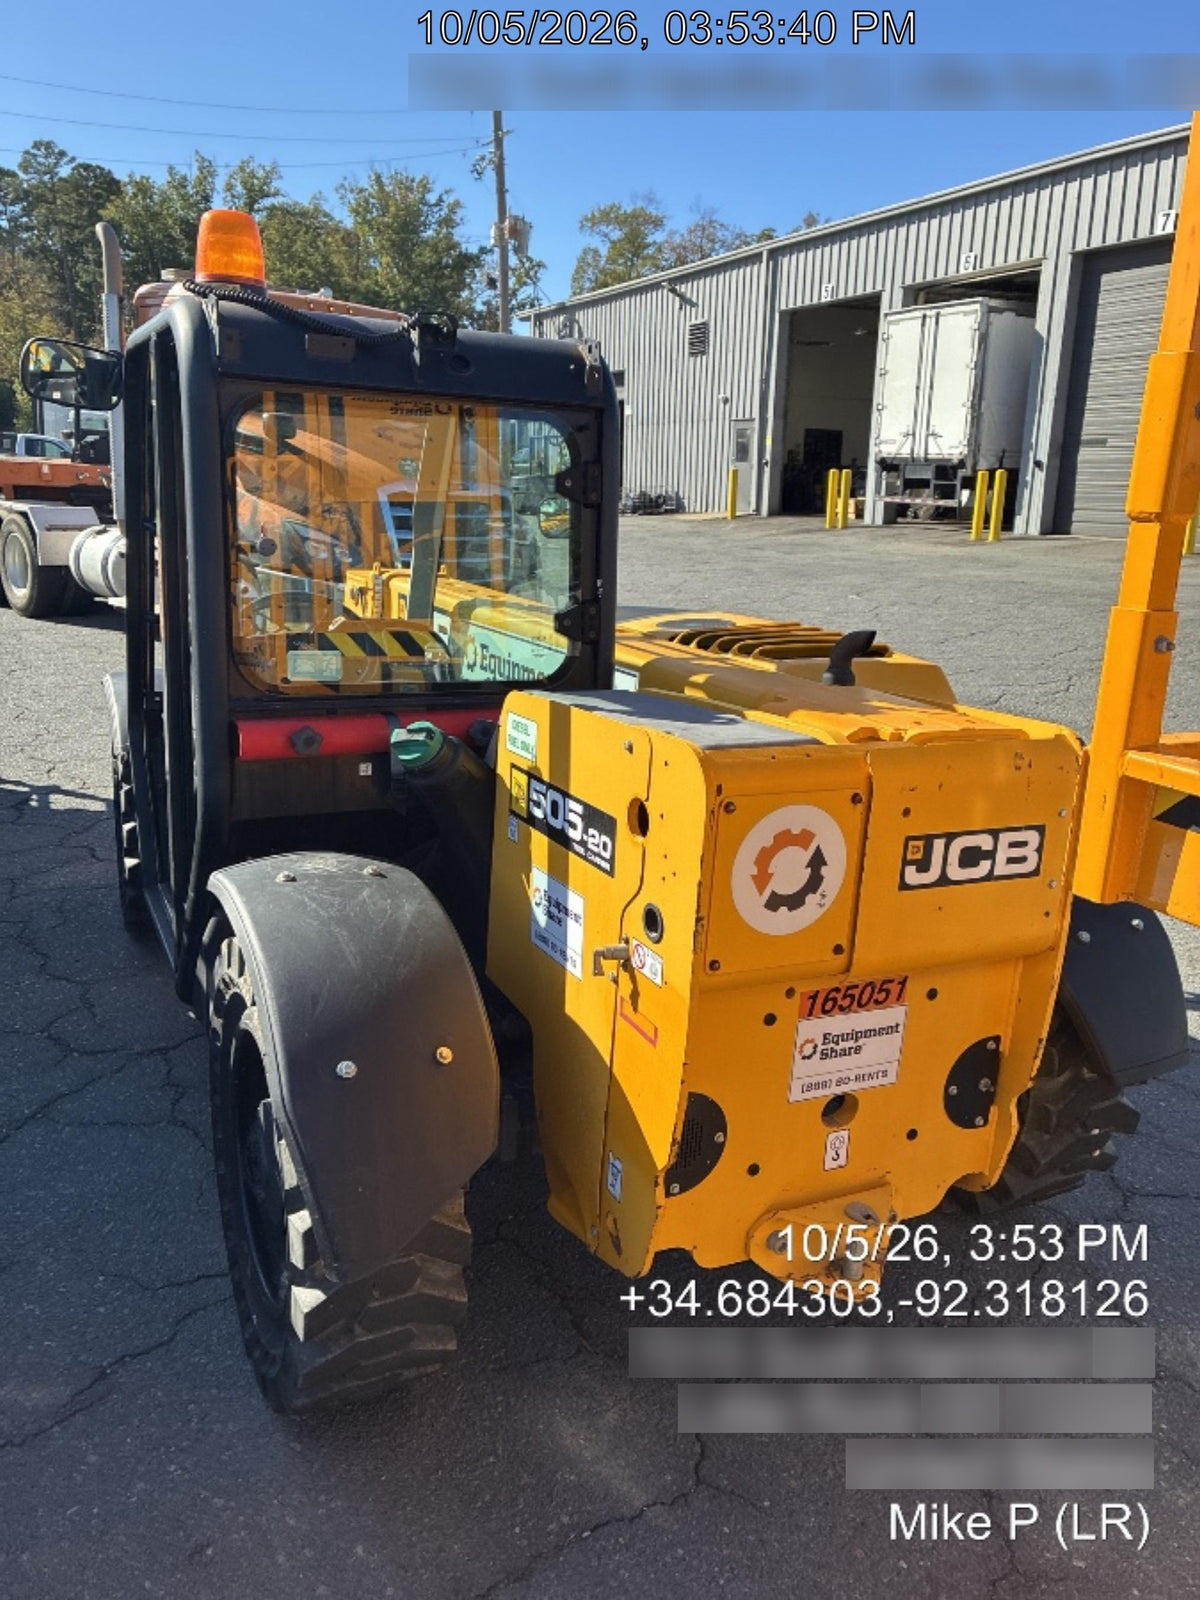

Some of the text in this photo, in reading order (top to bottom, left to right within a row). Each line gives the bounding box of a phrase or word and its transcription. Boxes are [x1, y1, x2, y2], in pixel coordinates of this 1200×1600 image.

[1162, 212, 1171, 231] 7
[964, 255, 971, 271] 6
[904, 829, 1041, 886] JCB
[806, 975, 908, 1018] 165051
[821, 1022, 901, 1048] Equipment
